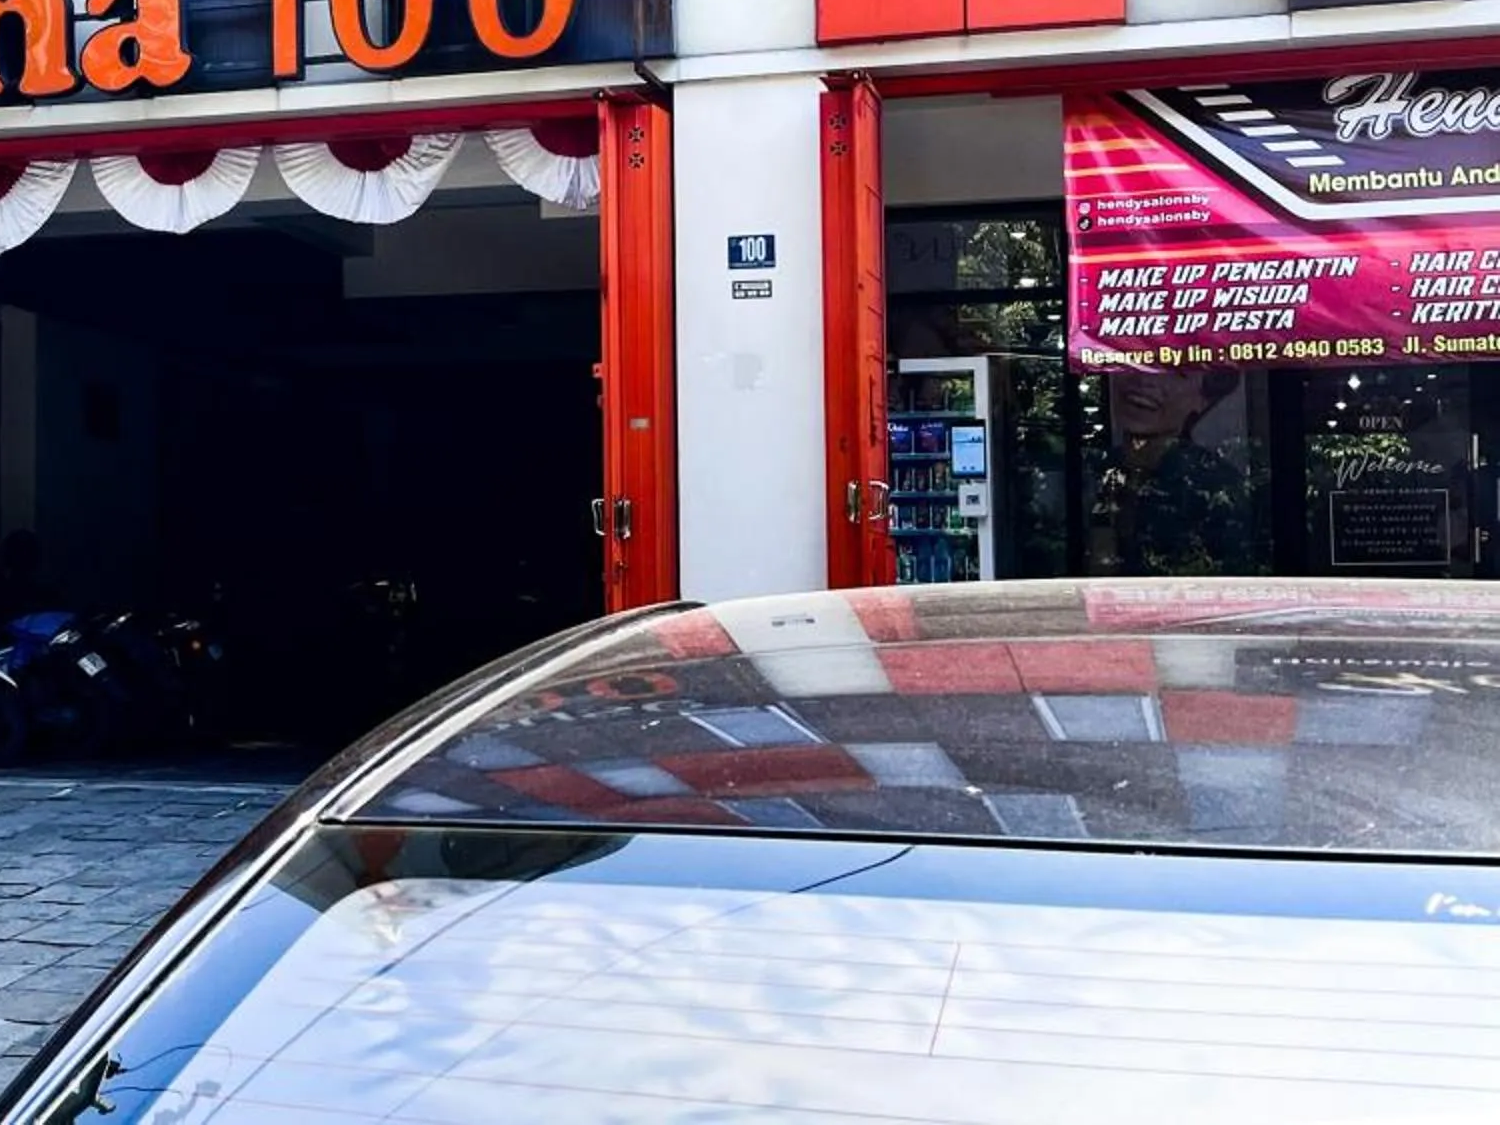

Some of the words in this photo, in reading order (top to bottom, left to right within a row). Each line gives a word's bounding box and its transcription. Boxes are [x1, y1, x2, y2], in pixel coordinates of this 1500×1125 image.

[1309, 166, 1442, 193] Membantu
[1096, 194, 1210, 211] hendysalonsby
[1096, 209, 1211, 227] hendysalonsby
[739, 236, 767, 262] 100
[1409, 250, 1476, 273] HAIR
[1098, 266, 1168, 290] MAKE
[1171, 264, 1208, 285] UP
[1211, 256, 1359, 283] PENGANTIN
[1098, 290, 1168, 313] MAKE
[1172, 288, 1208, 309] UP
[1212, 283, 1309, 308] WISUDA
[1409, 275, 1476, 298] HAIR
[1098, 314, 1169, 337] MAKE
[1173, 312, 1209, 334] UP
[1213, 309, 1295, 332] PESTA
[1081, 346, 1154, 365] Reserve
[1160, 346, 1181, 366] By
[1229, 342, 1278, 360] 0812
[1283, 340, 1330, 358] 4940
[1336, 338, 1384, 357] 0583
[1358, 415, 1403, 430] OPEN
[1334, 447, 1446, 489] Welcome
